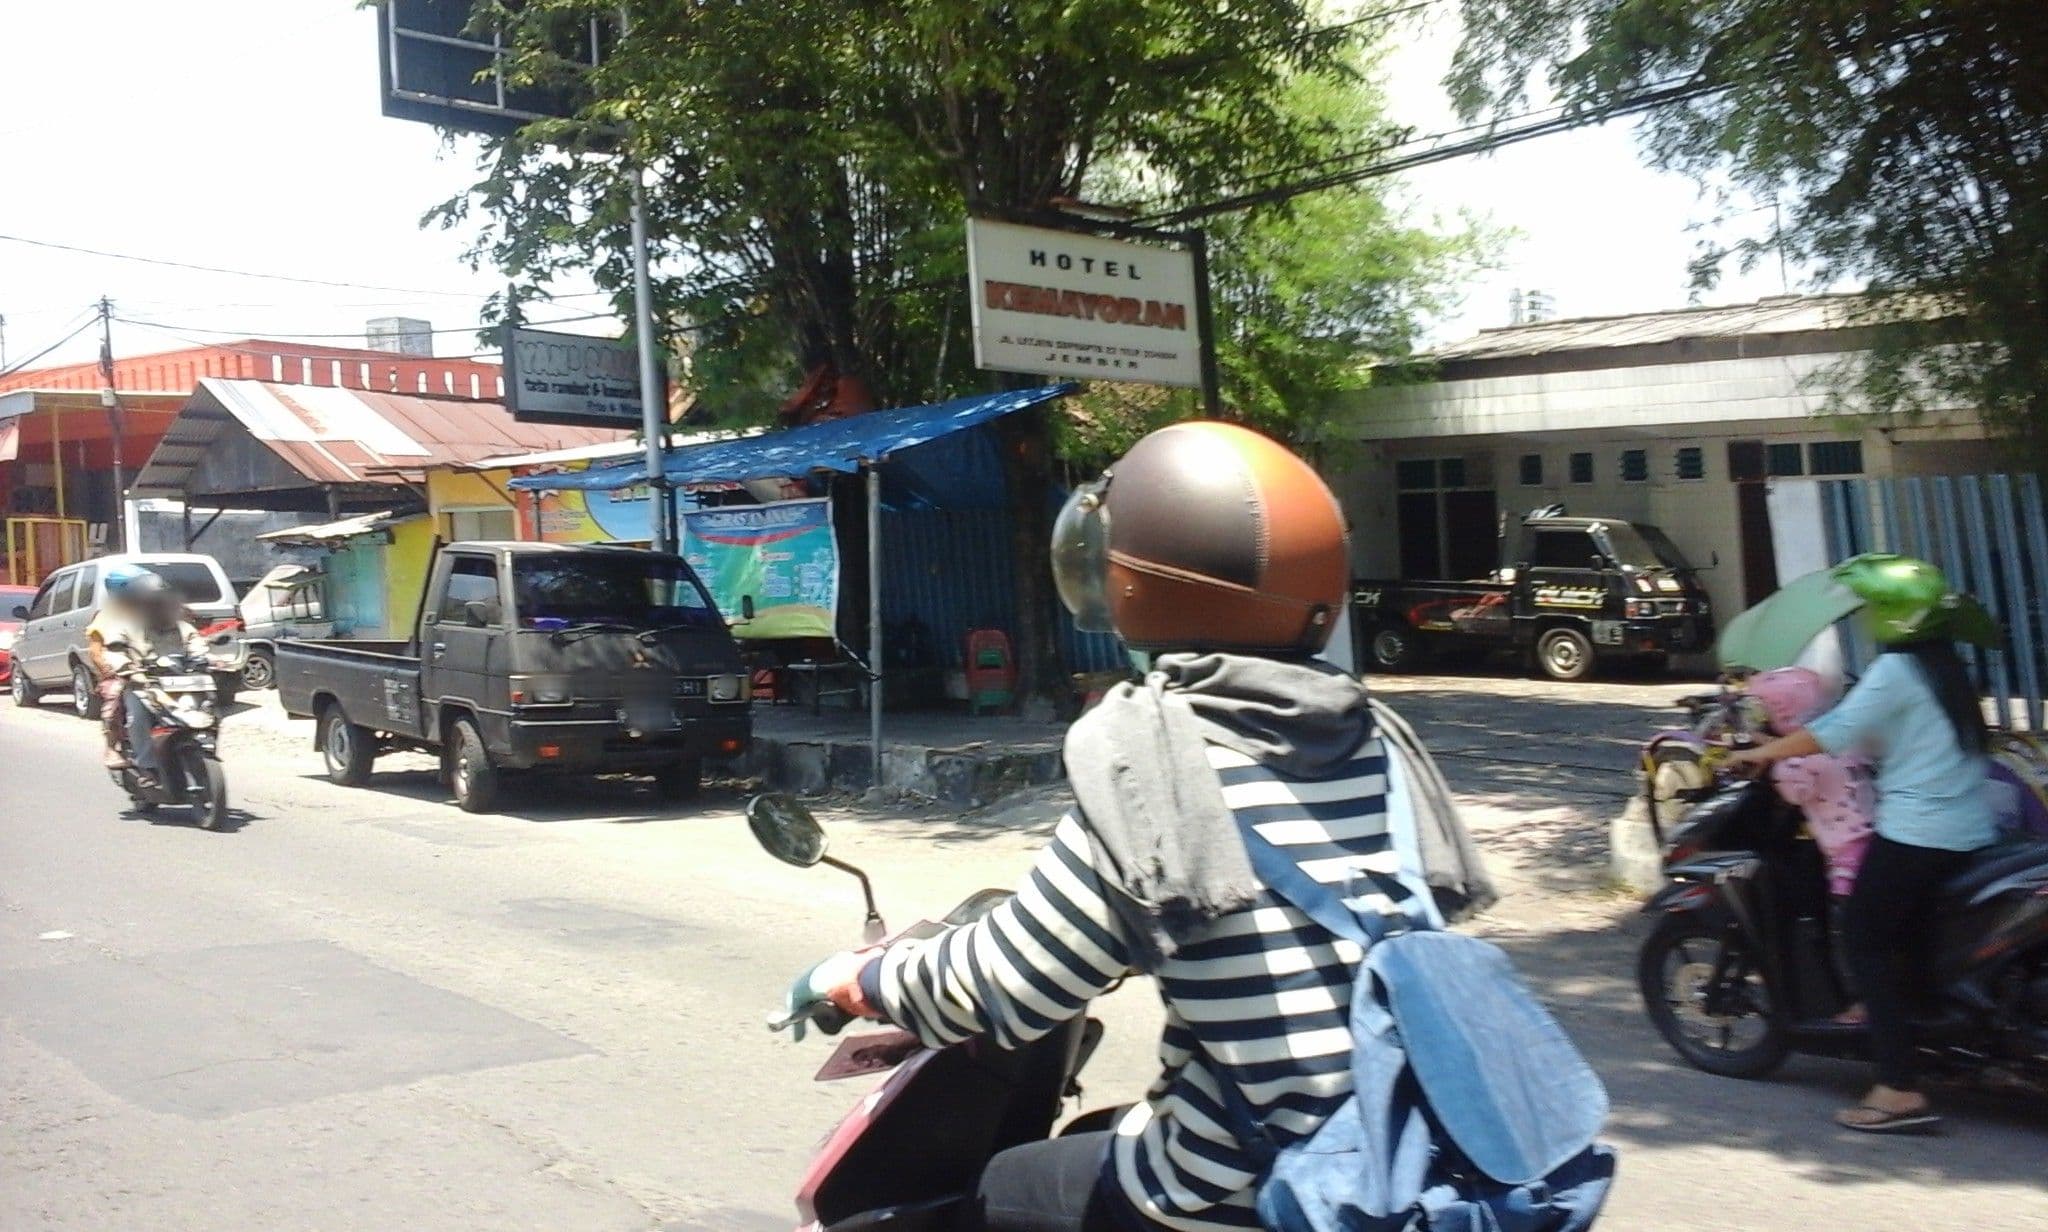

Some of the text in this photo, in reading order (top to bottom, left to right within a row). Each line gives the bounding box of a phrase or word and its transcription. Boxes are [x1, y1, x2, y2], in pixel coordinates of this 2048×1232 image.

[1029, 250, 1142, 280] HOTEL
[984, 280, 1187, 331] KEMAYORAN
[1045, 353, 1139, 369] JEMBER
